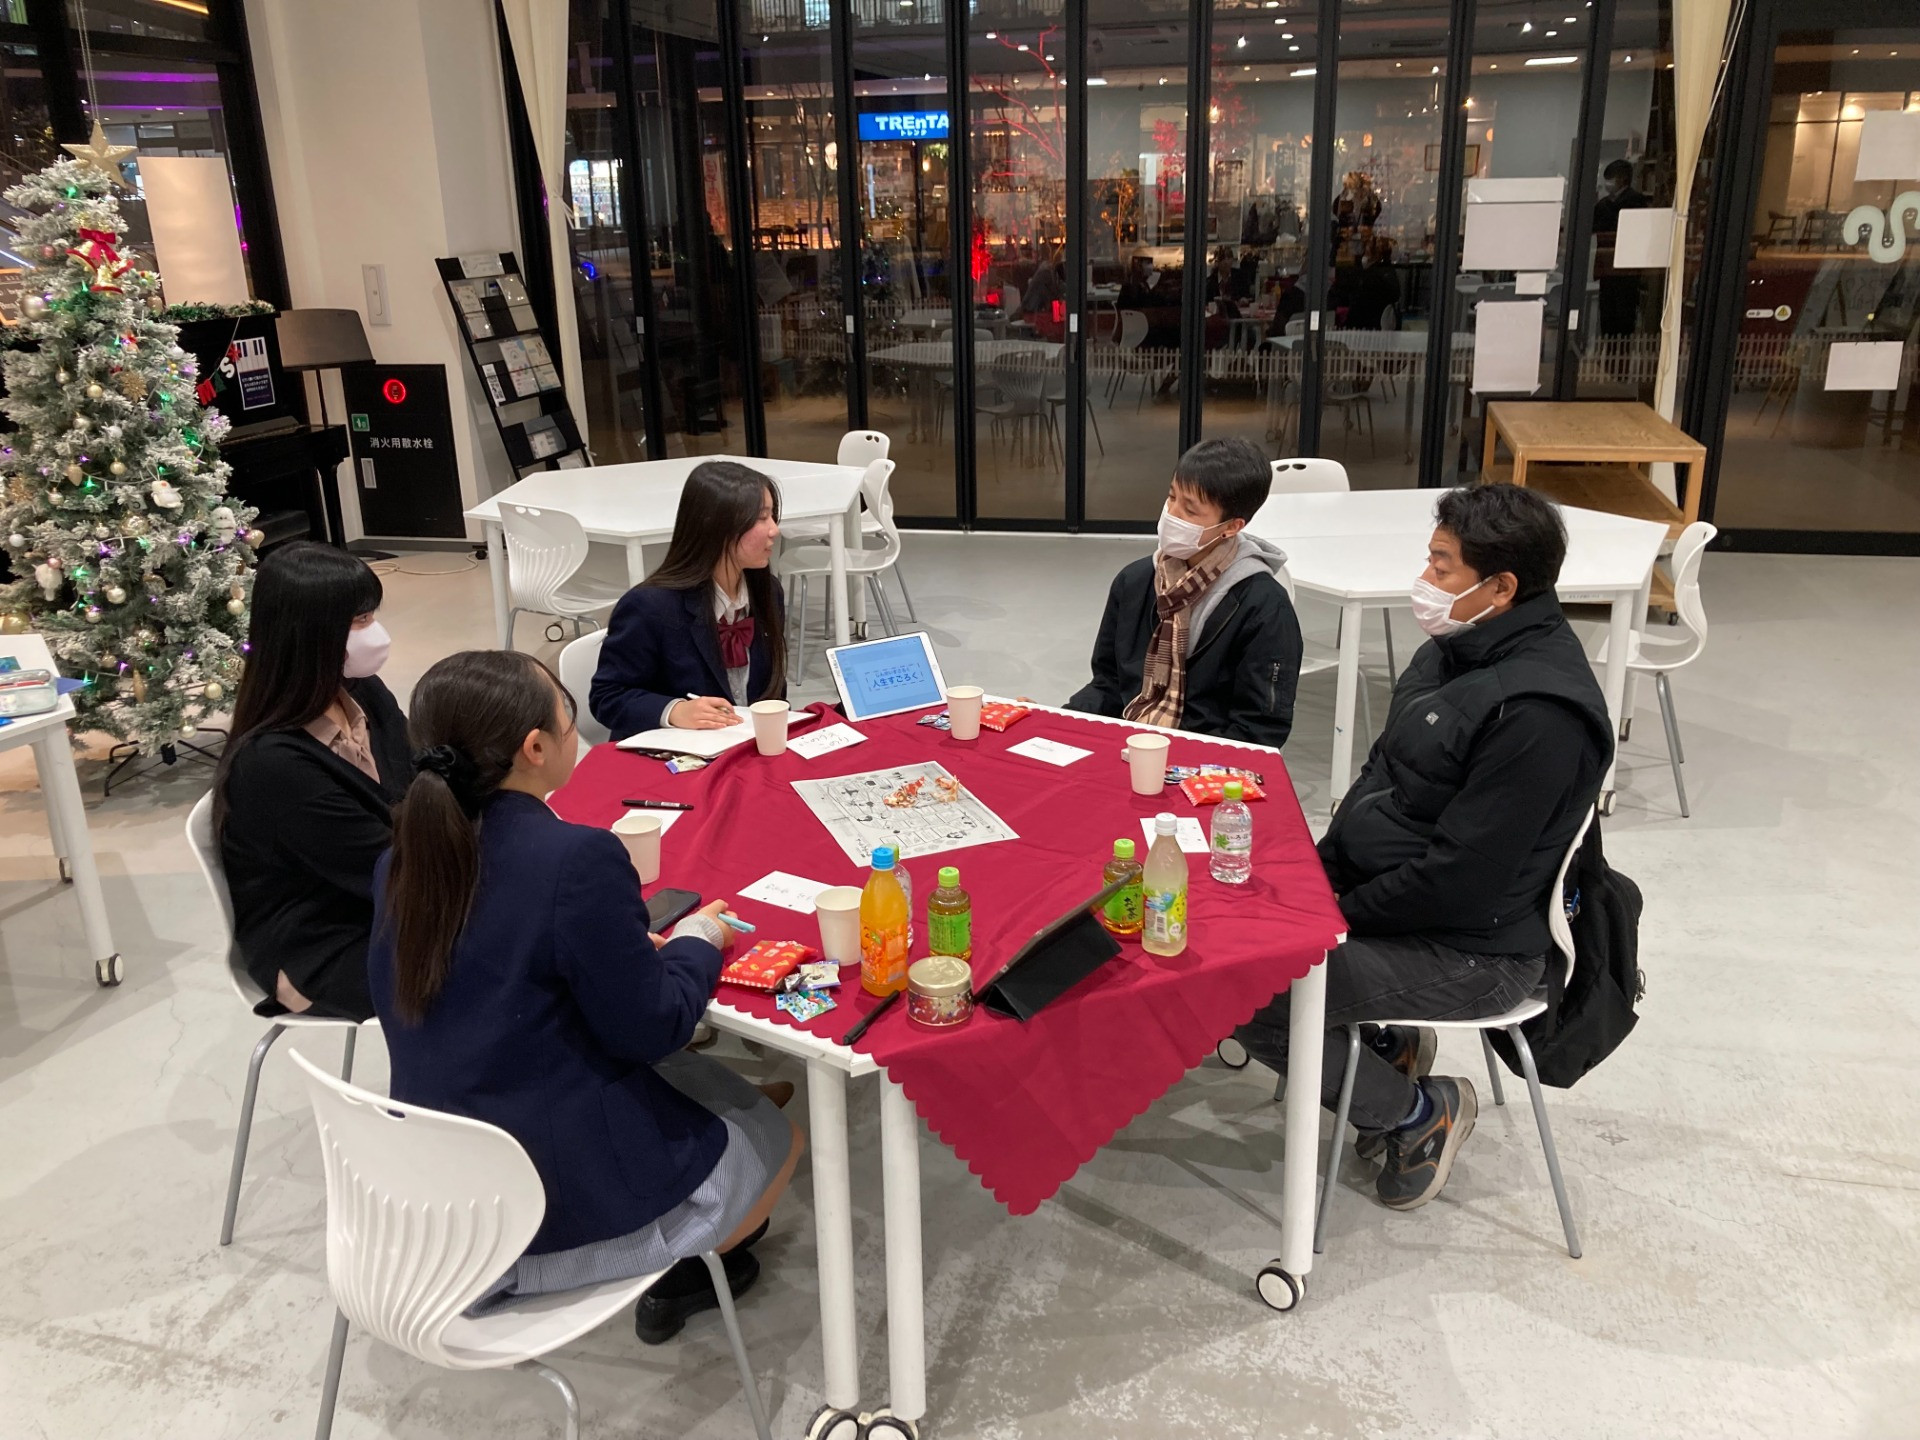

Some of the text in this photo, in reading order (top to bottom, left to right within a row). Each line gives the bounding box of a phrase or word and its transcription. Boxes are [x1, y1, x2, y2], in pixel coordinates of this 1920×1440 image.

[369, 436, 434, 449] 消火用散水栓
[873, 672, 918, 687] 人生すごろく
